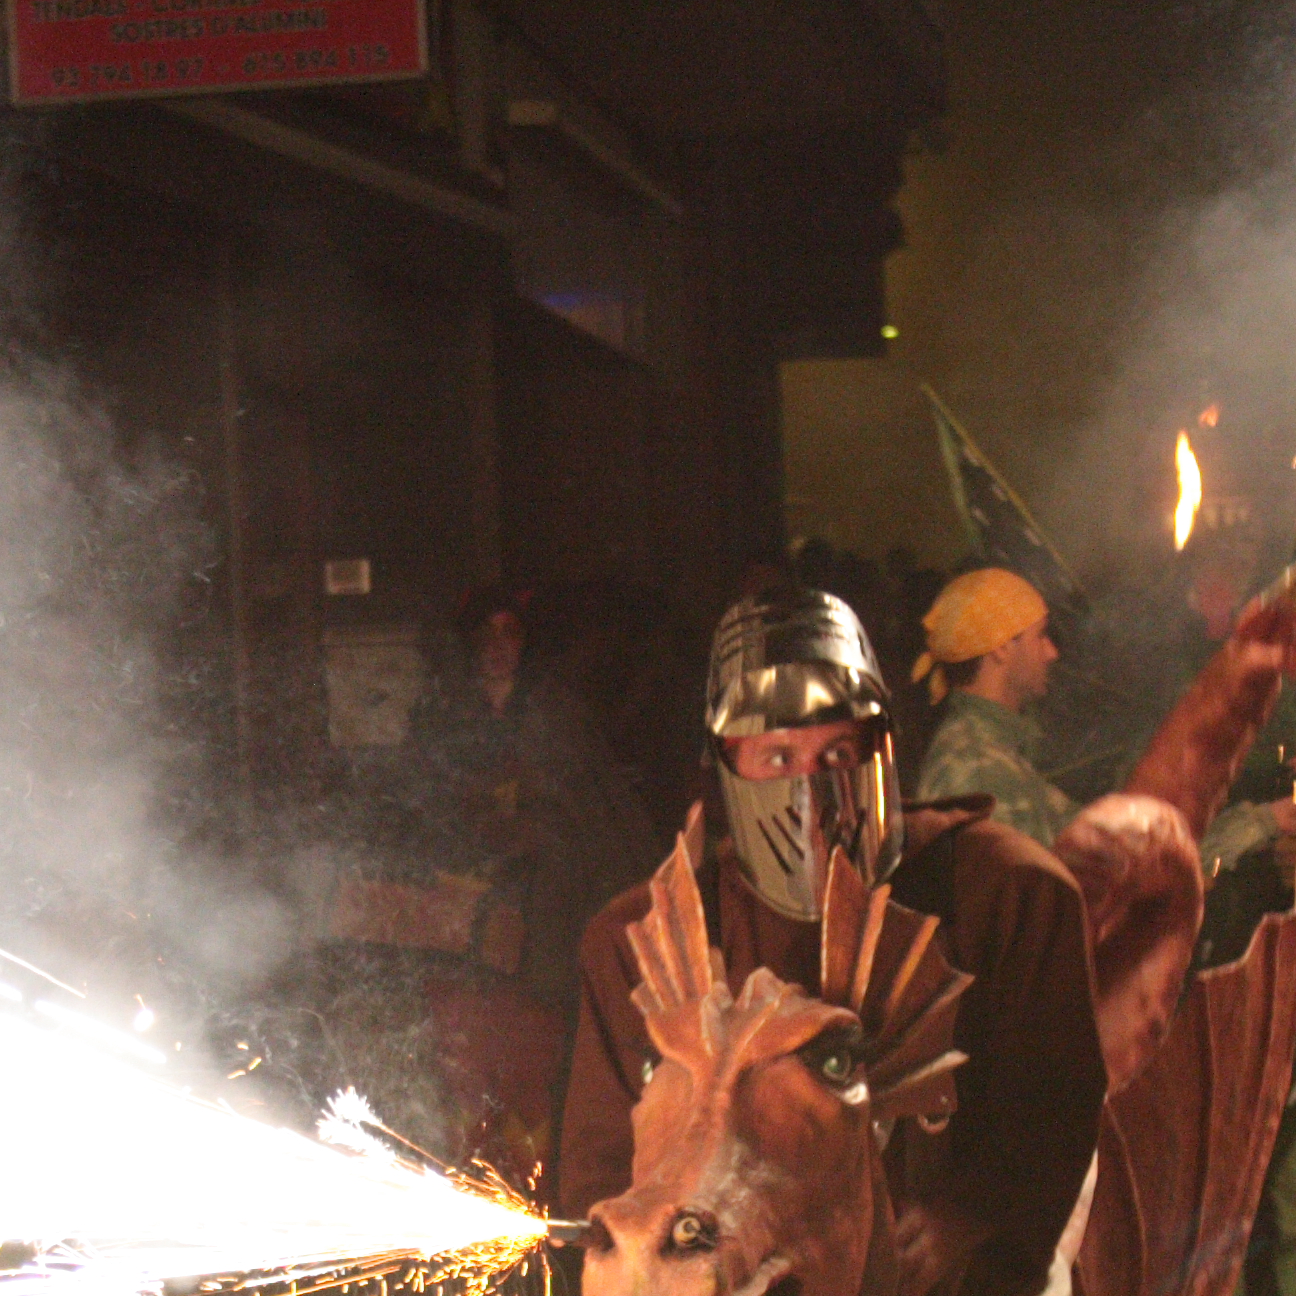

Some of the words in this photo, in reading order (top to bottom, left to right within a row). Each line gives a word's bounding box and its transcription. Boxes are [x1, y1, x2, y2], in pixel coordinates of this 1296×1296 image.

[110, 18, 204, 42] SOSTRES
[51, 66, 80, 88] 93
[90, 63, 132, 85] 794
[142, 60, 168, 82] 18
[176, 57, 204, 80] 97
